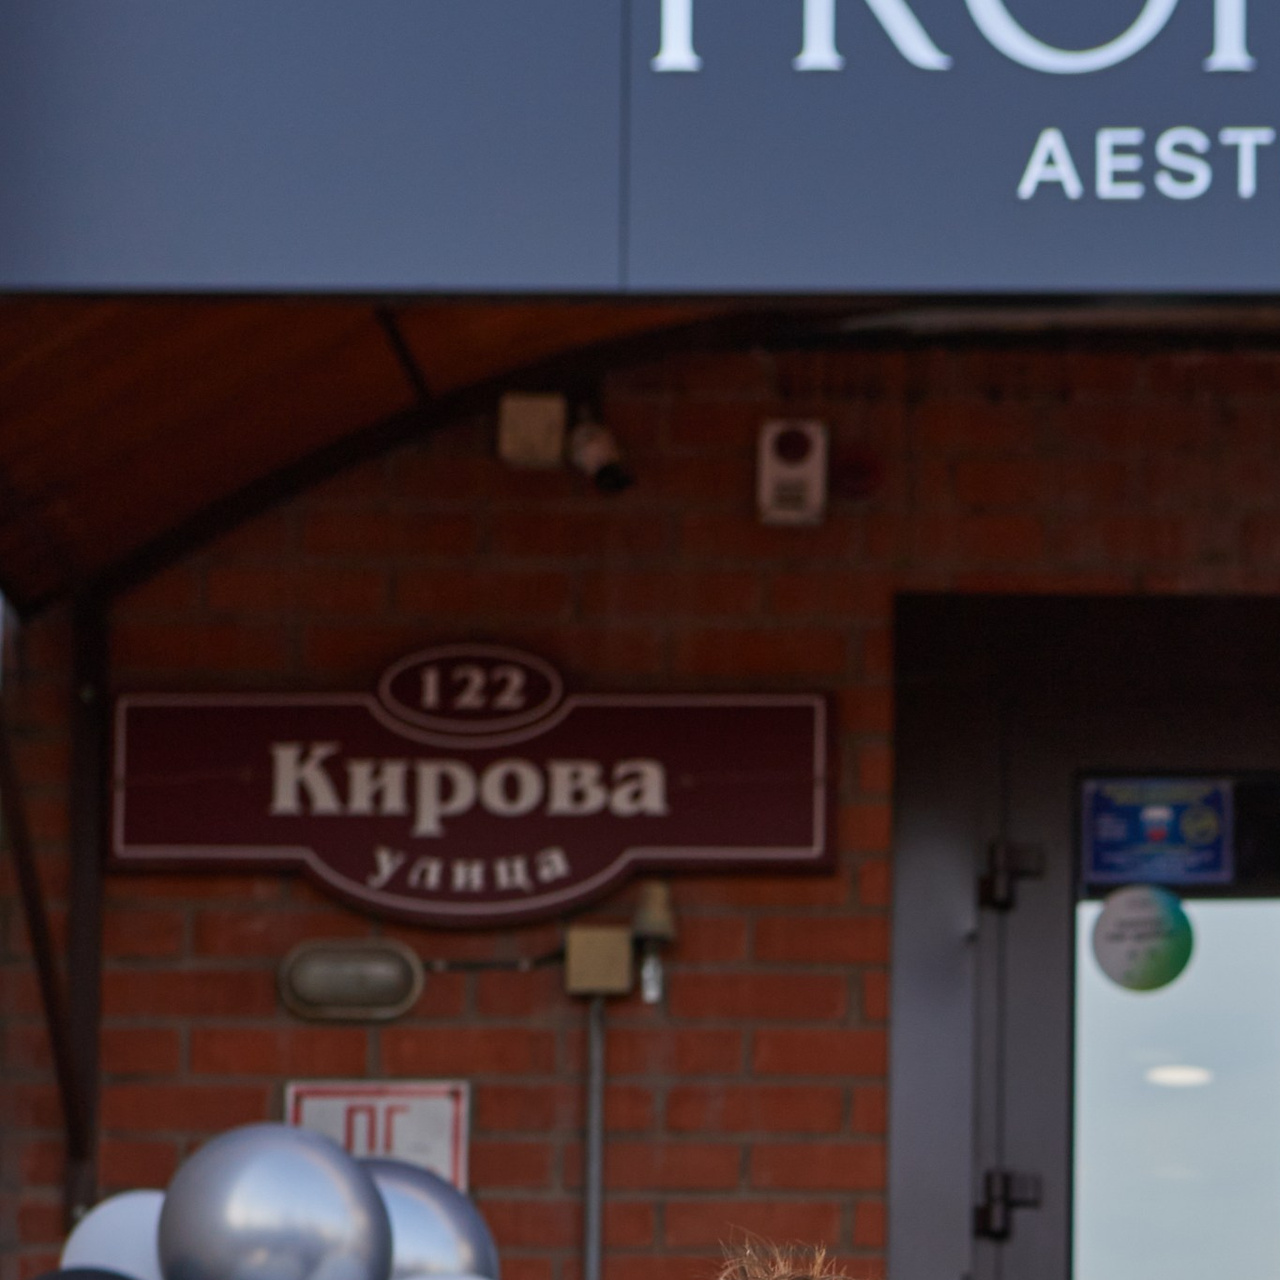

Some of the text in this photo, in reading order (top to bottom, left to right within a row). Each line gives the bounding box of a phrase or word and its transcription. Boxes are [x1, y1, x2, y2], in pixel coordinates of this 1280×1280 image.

[420, 665, 525, 709] 122
[270, 743, 668, 837] Кирова
[366, 846, 570, 893] улица
